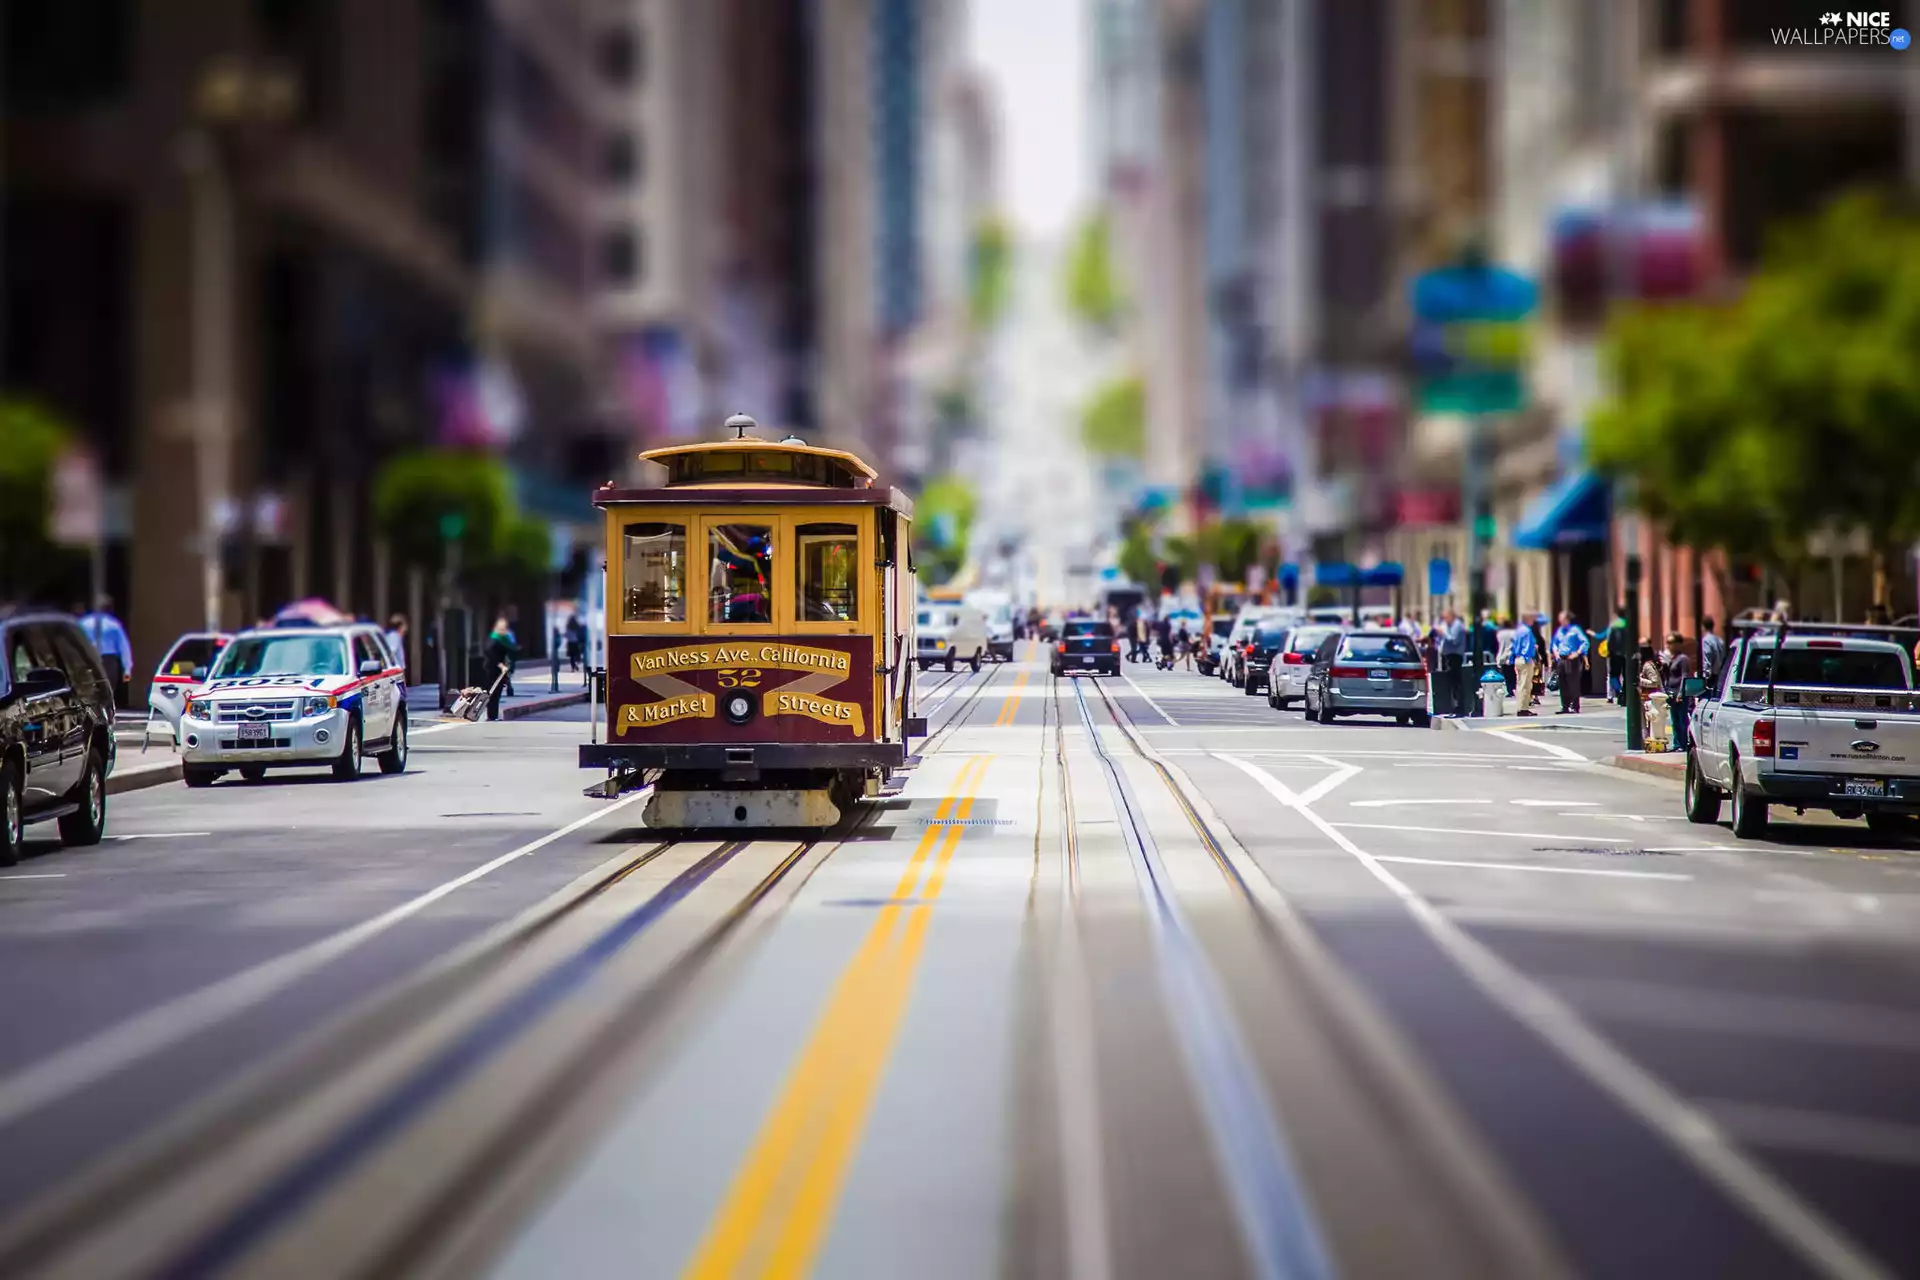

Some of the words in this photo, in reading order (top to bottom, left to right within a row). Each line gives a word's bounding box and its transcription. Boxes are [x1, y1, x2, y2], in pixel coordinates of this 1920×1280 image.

[635, 655, 665, 671] Van
[667, 650, 709, 667] Ness
[760, 646, 848, 671] California
[717, 668, 761, 688] 52
[627, 706, 640, 722] &
[644, 697, 707, 721] Market
[779, 694, 851, 719] Streets
